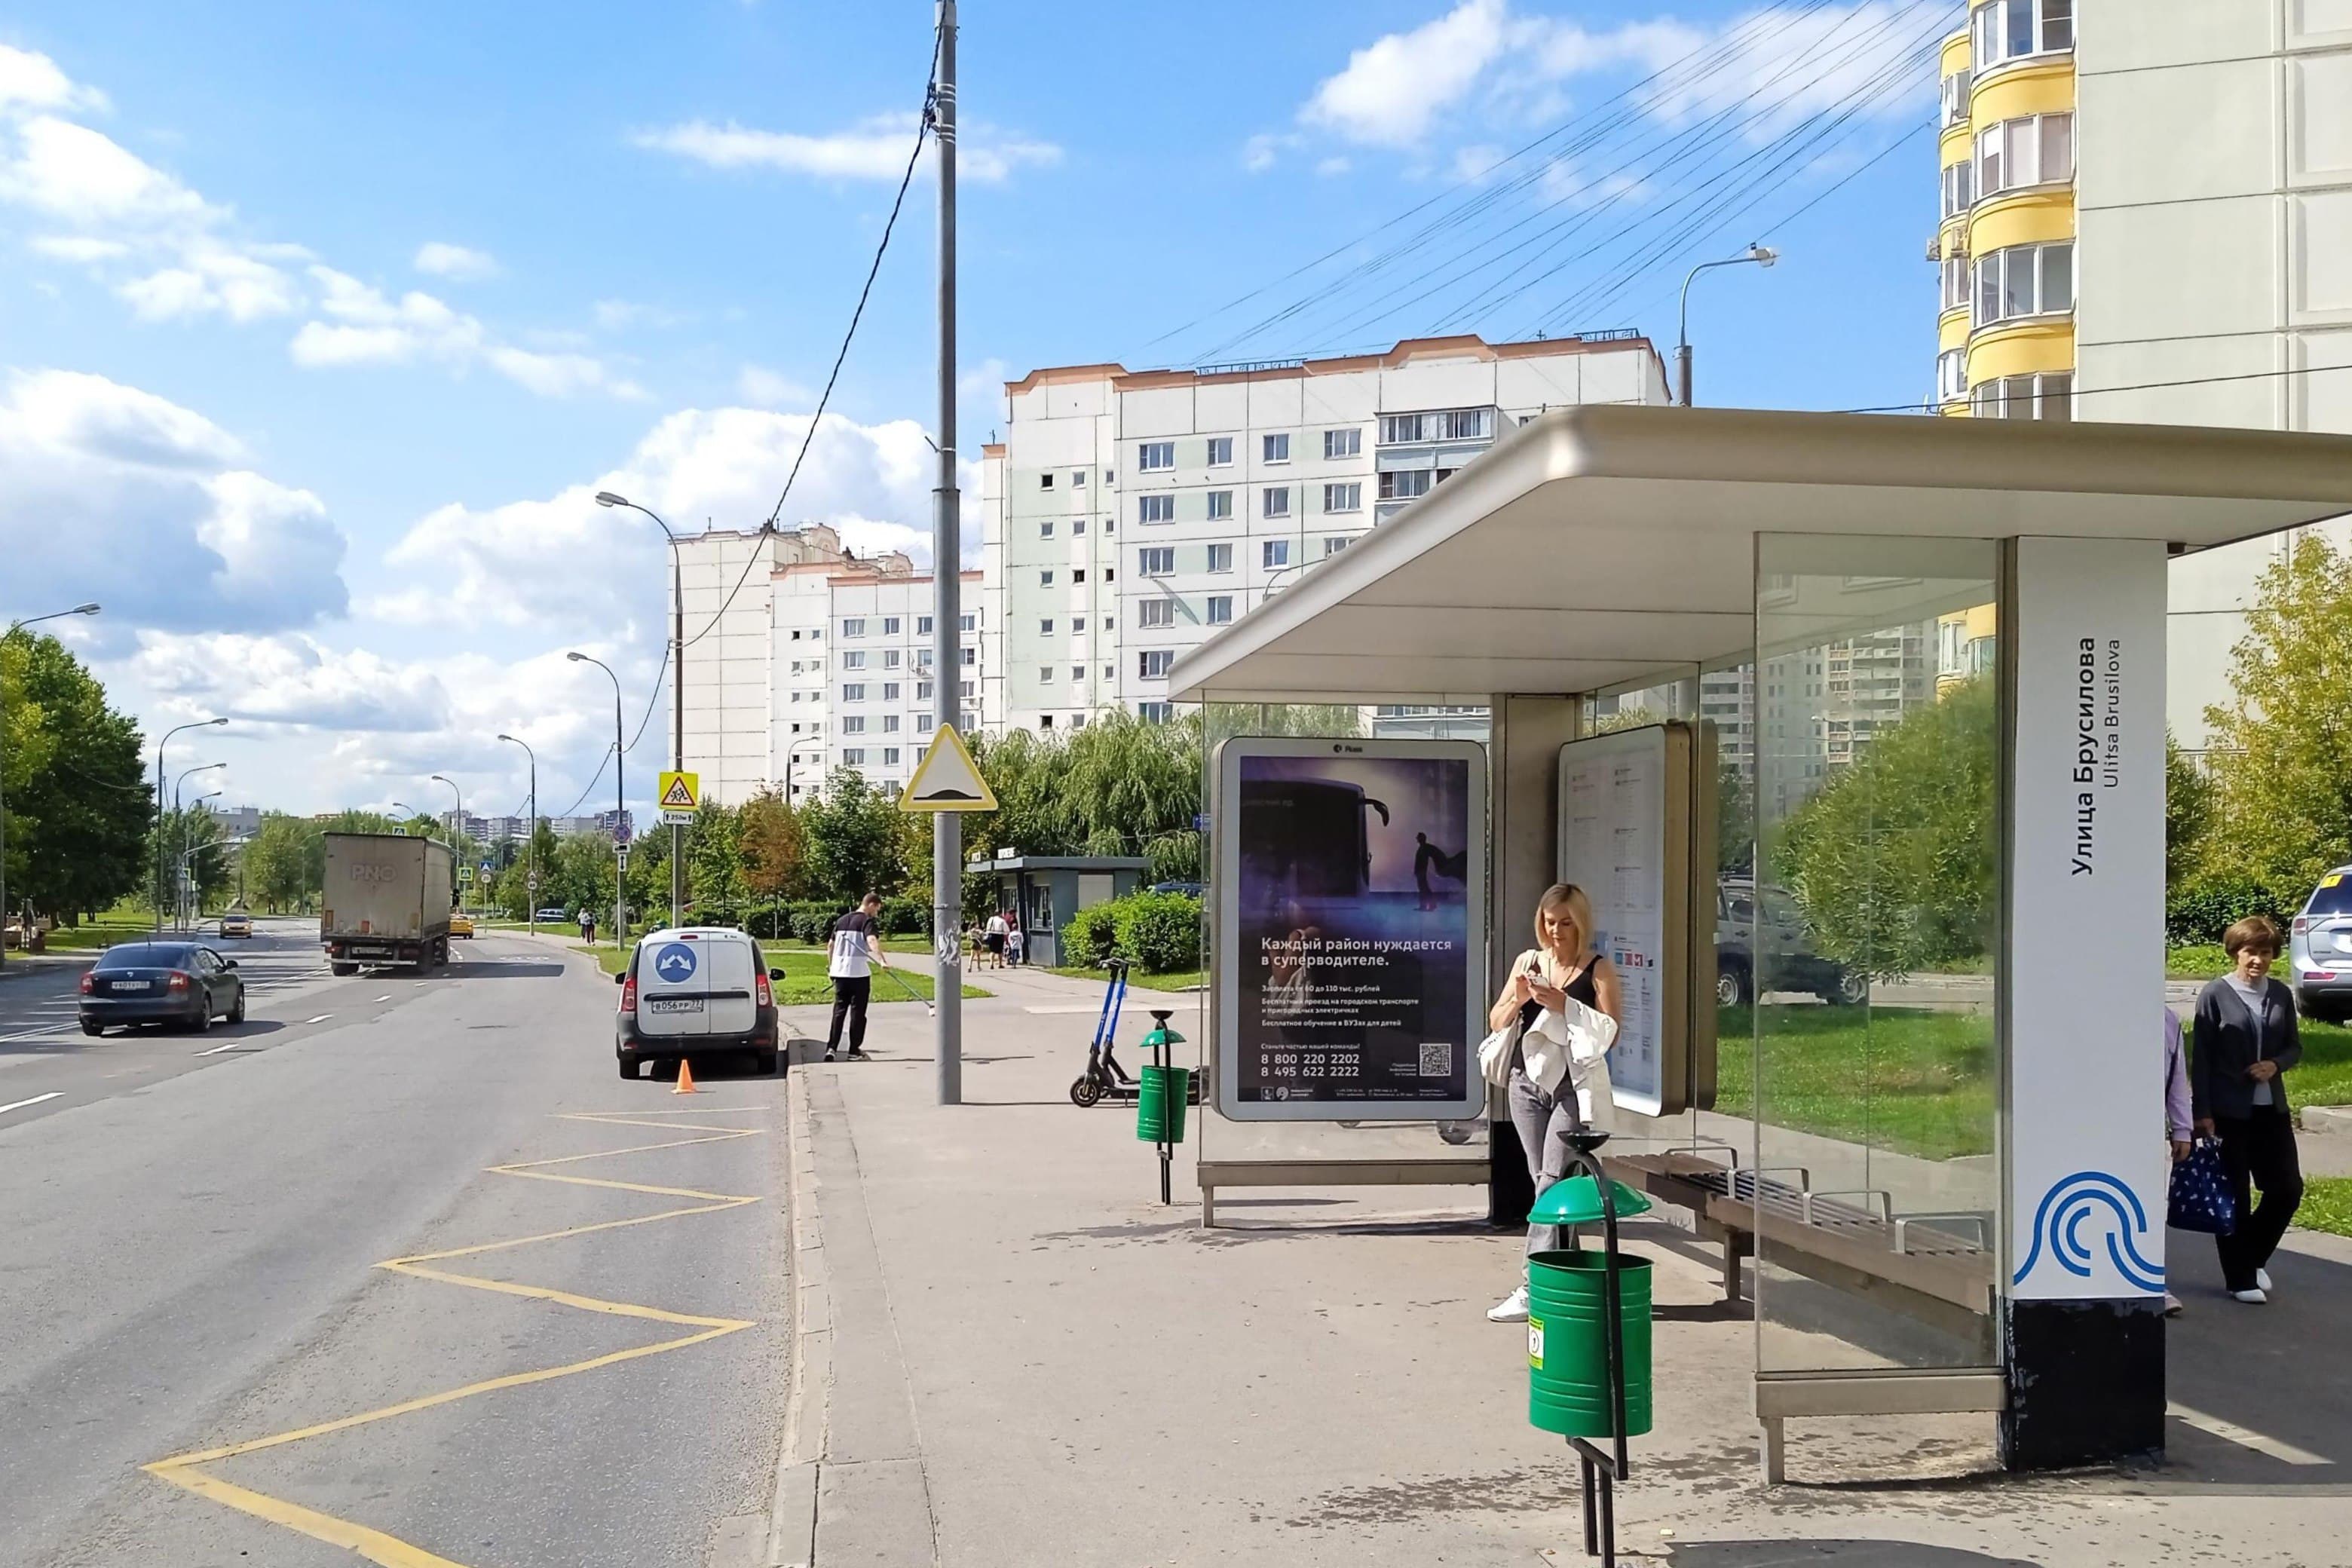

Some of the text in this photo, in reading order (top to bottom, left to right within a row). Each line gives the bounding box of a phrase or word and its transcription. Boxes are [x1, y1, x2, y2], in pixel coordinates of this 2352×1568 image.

[2103, 639, 2120, 788] Ulitsa Brusilova
[2072, 637, 2099, 876] Улица Брусилова
[1261, 937, 1451, 953] Каждый район нуждается
[1261, 956, 1389, 968] в суперводителе.
[1355, 985, 1380, 994] рублей
[1303, 1019, 1337, 1027] обучение
[1260, 1054, 1360, 1064] 8 800 220 2202
[1260, 1067, 1360, 1076] 8 495 622 2222
